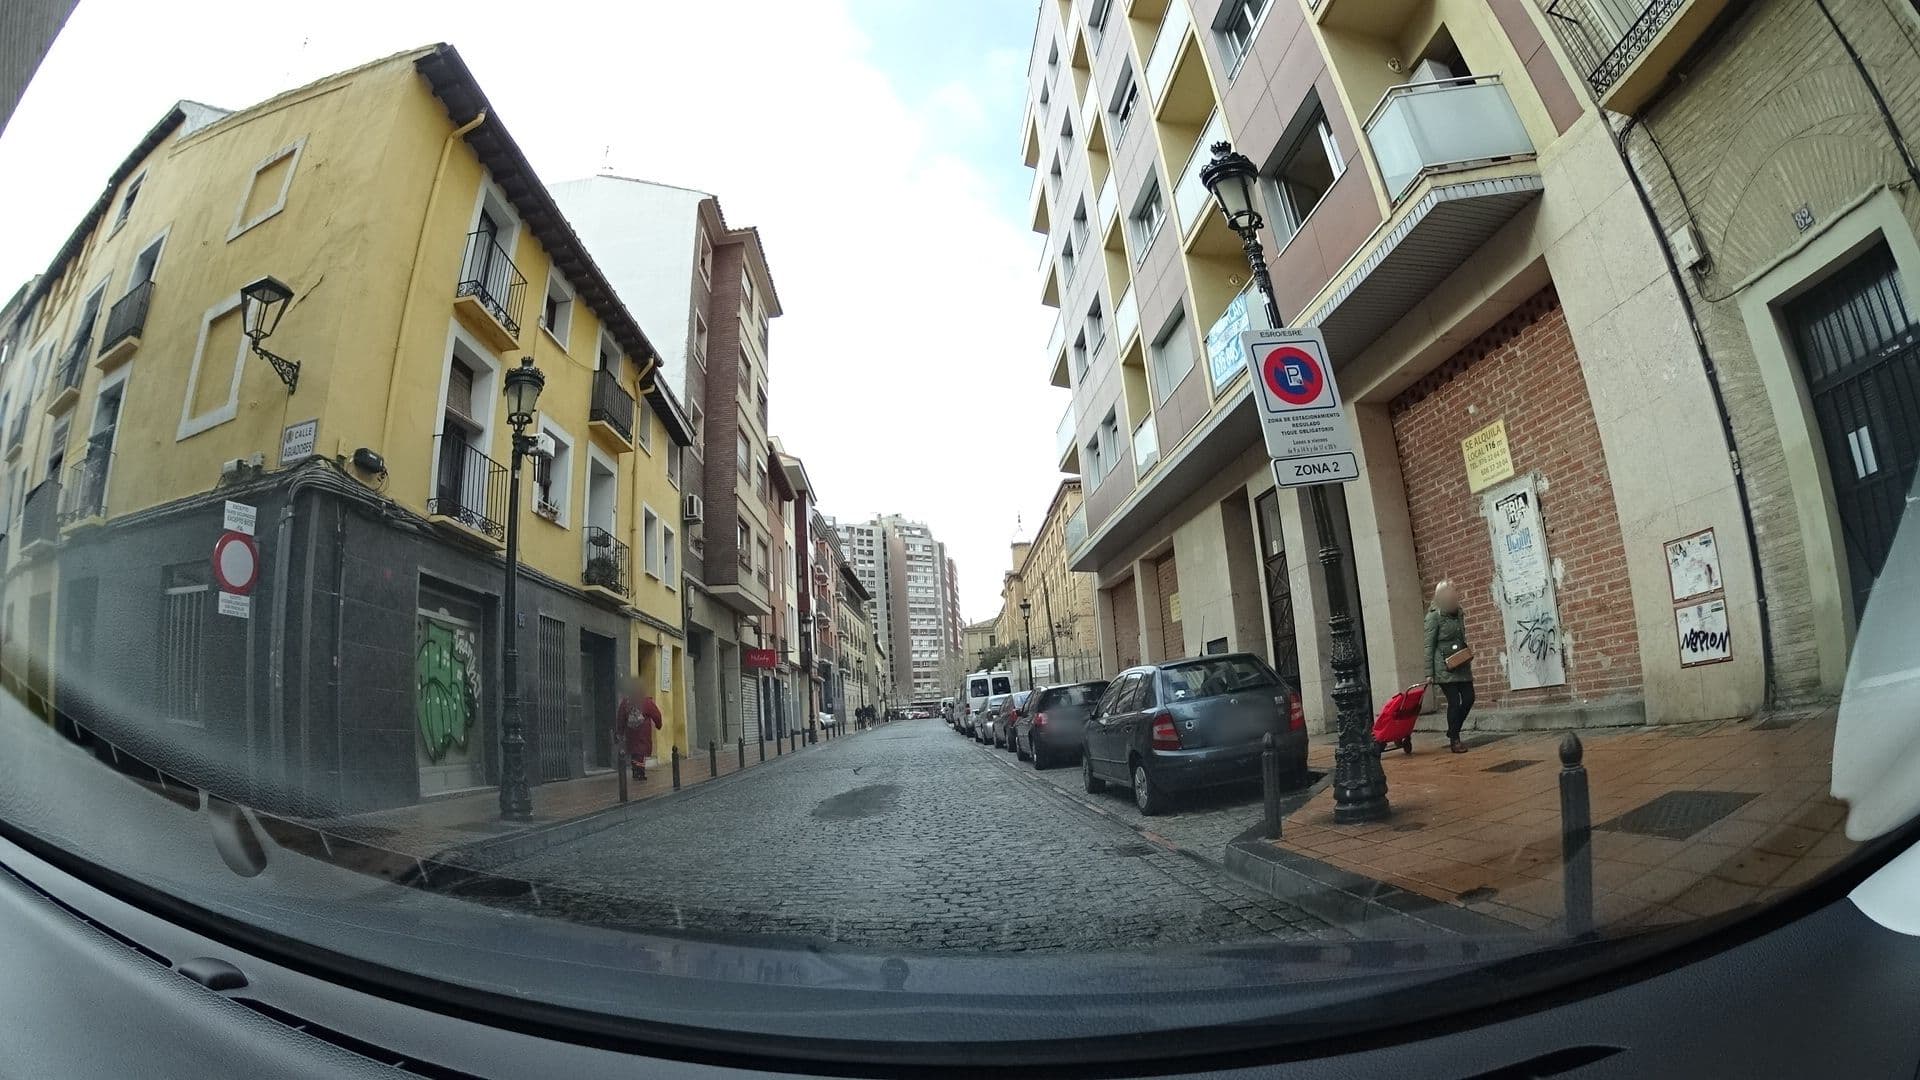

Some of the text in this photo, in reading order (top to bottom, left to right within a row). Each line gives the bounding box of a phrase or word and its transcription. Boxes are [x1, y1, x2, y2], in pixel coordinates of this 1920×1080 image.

[1795, 208, 1813, 229] 82
[1292, 412, 1340, 421] ESTACIONAMIENTO
[295, 427, 313, 440] CALLE
[1299, 426, 1335, 434] OBLIGATORIO
[1465, 425, 1502, 451] SE ALQUILA
[284, 441, 312, 457] AGUADORES
[1467, 447, 1485, 462] LOCAL
[1485, 440, 1496, 451] 116
[1294, 461, 1340, 477] ZONA 2
